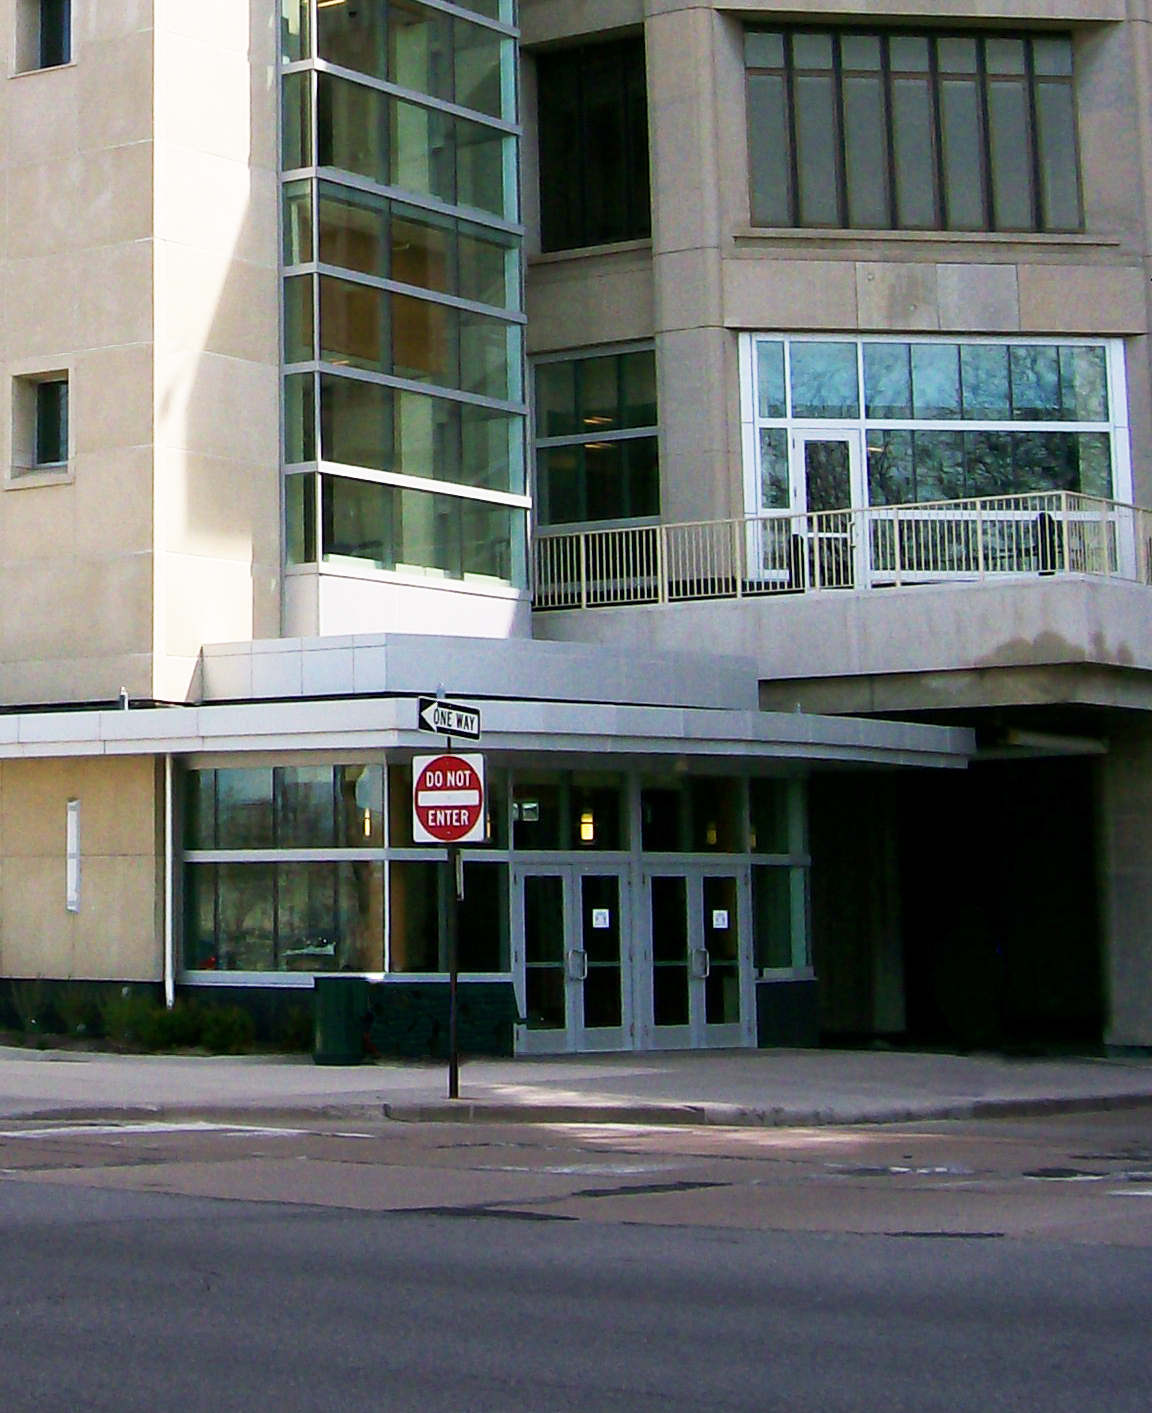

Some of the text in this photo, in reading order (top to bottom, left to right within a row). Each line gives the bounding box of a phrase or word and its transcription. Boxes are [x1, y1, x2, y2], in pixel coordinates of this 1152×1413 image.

[433, 708, 476, 732] ONE WAY
[425, 770, 471, 788] DO NOT
[428, 809, 469, 826] ENTER
